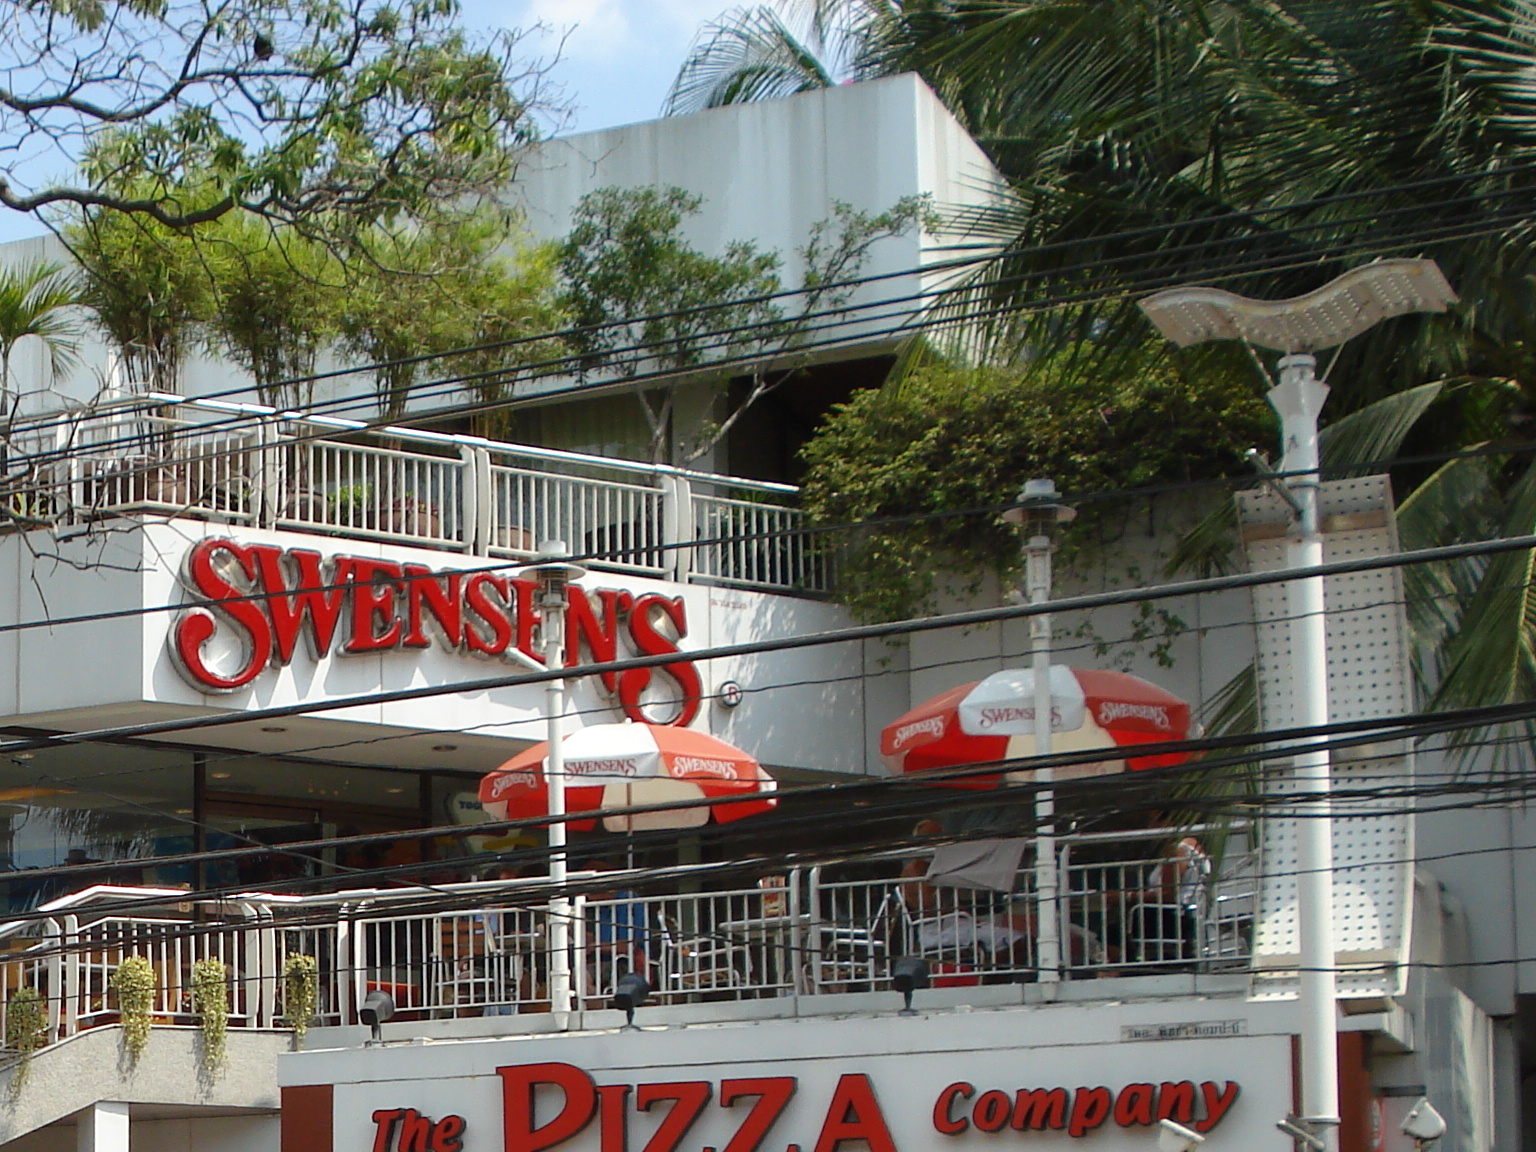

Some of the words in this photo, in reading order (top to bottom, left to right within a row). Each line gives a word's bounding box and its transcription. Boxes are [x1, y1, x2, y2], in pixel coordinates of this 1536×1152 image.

[1099, 701, 1170, 727] SWENSEN'S
[563, 758, 637, 780] SWENSEN'S
[673, 756, 738, 780] SWENSEN'S
[932, 1080, 1240, 1138] Company
